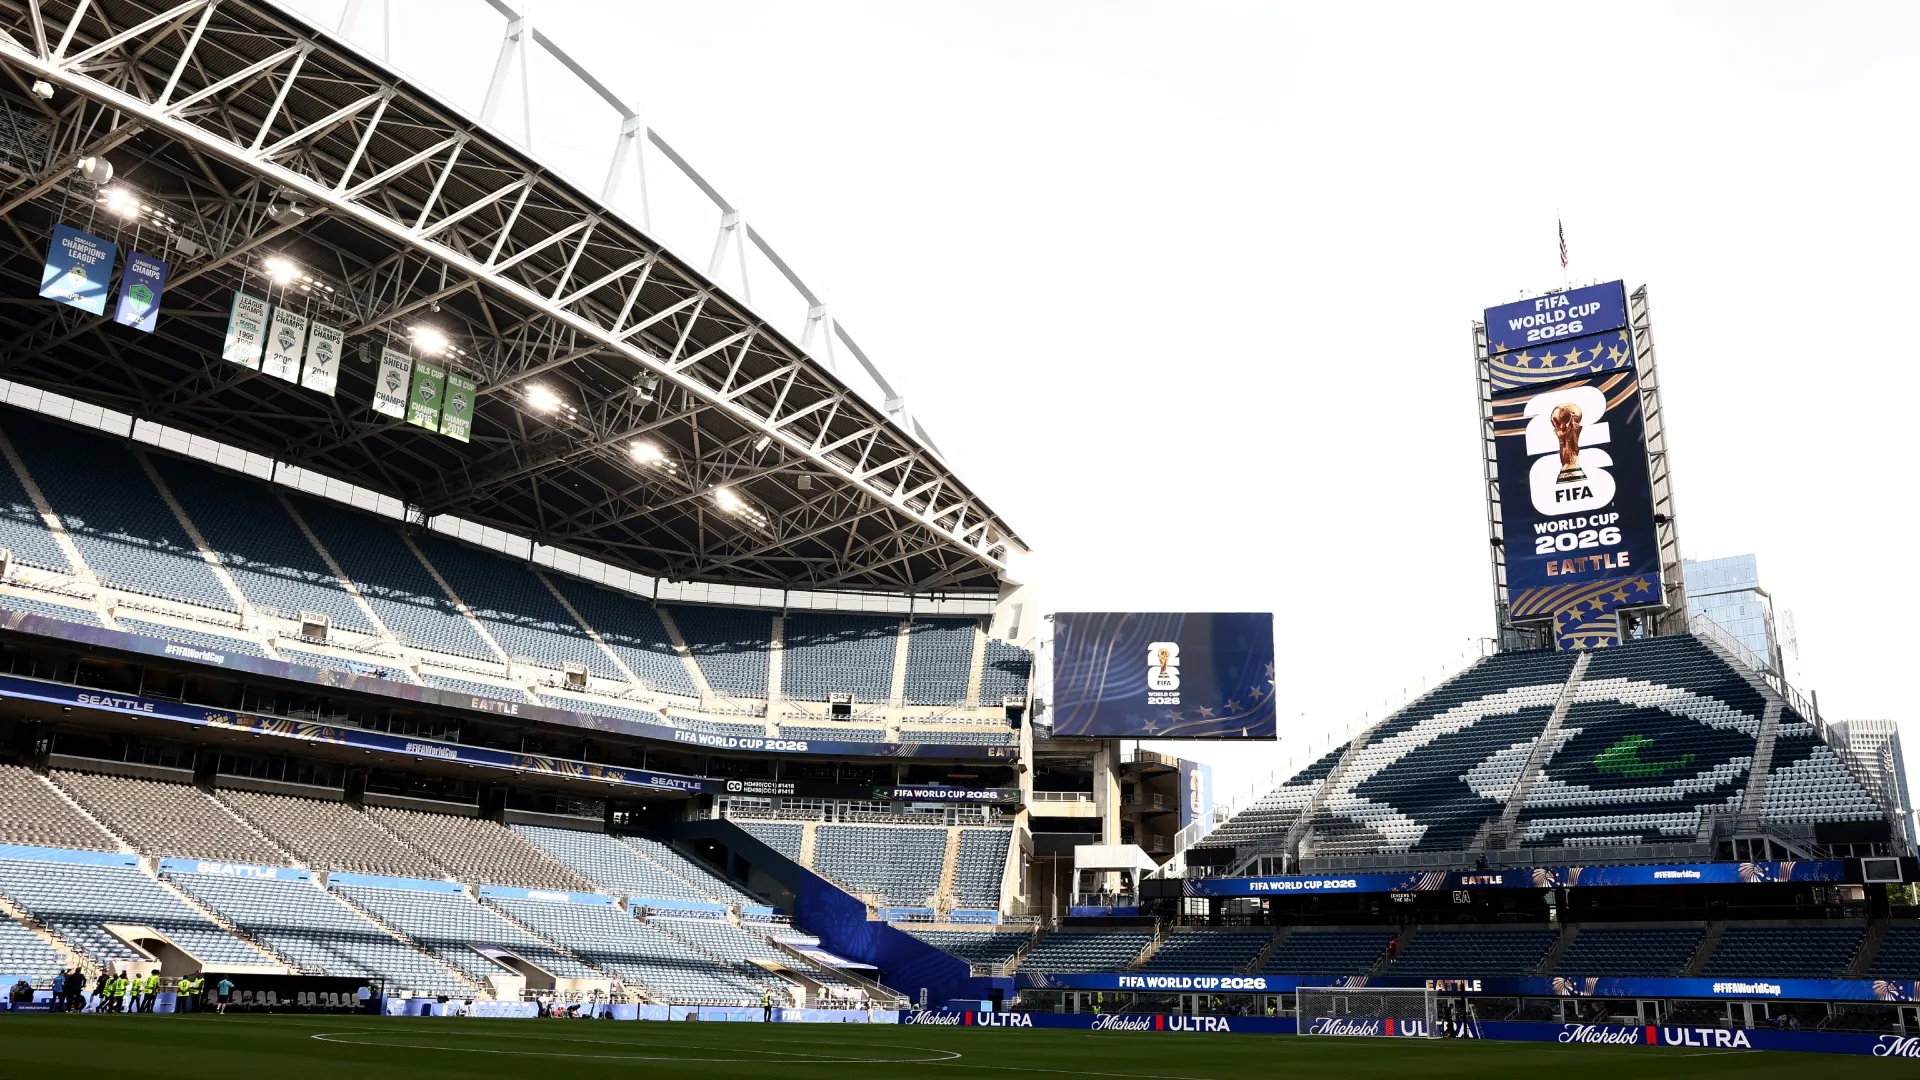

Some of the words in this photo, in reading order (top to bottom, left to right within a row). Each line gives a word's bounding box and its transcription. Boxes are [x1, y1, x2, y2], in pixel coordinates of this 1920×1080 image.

[62, 238, 106, 260] CHAMPIONS
[68, 249, 97, 265] LEAGUE
[132, 263, 160, 280] CHAMPS
[238, 303, 264, 317] CHAMPS
[240, 297, 264, 309] LEAGUE
[1535, 294, 1570, 312] FIFA
[276, 315, 304, 331] CHAMPS
[1508, 309, 1566, 331] WORLD
[1568, 301, 1601, 319] CUP
[313, 328, 341, 345] CHAMPS
[1527, 320, 1584, 342] 2026
[383, 356, 409, 372] SHIELD
[416, 364, 430, 375] MLS
[431, 368, 444, 380] CUP
[449, 376, 462, 387] MLS
[462, 380, 476, 392] CUP
[376, 392, 405, 408] CHAMPS
[412, 402, 438, 418] CHAMPS
[444, 414, 470, 429] CHAMPS
[1555, 486, 1594, 503] FIFA
[1533, 516, 1587, 535] WORLD
[1589, 512, 1620, 526] CUP
[1535, 526, 1622, 555] 2026
[1546, 551, 1631, 577] EATTLE
[164, 644, 225, 665] #FIFAWorldCup
[77, 693, 154, 713] SEATTLE
[471, 698, 519, 715] EATTLE
[1148, 697, 1180, 705] 2026
[674, 730, 697, 743] FIFA
[698, 734, 738, 749] WORLD
[739, 738, 764, 750] CUP
[765, 740, 808, 751] 2026
[406, 742, 458, 760] #FIFAWorldCup
[650, 776, 702, 790] SEATTLE
[894, 789, 913, 797] FIFA
[914, 790, 946, 798] WORLD
[948, 790, 966, 798] CUP
[966, 791, 998, 799] 2026
[196, 862, 278, 878] SEATTLE
[1654, 870, 1701, 881] #FIFAWorldCup
[1250, 882, 1269, 890] FIFA
[1270, 881, 1302, 890] WORLD
[1304, 880, 1323, 890] CUP
[1324, 880, 1357, 889] 2026
[1461, 876, 1503, 885] EATTLE
[1118, 976, 1146, 988] FIFA
[1147, 977, 1192, 989] WORLD
[1194, 978, 1219, 989] CUP
[1220, 978, 1266, 990] 2026
[1713, 982, 1781, 996] #FIFAWorldCup
[904, 1010, 961, 1026] Michelob
[977, 1012, 1033, 1027] ULTRA
[1092, 1013, 1150, 1031] Michelob
[1168, 1016, 1231, 1032] ULTRA
[1310, 1017, 1379, 1036] Michelob
[1558, 1023, 1638, 1045] Michelob
[1664, 1027, 1752, 1048] ULTRA
